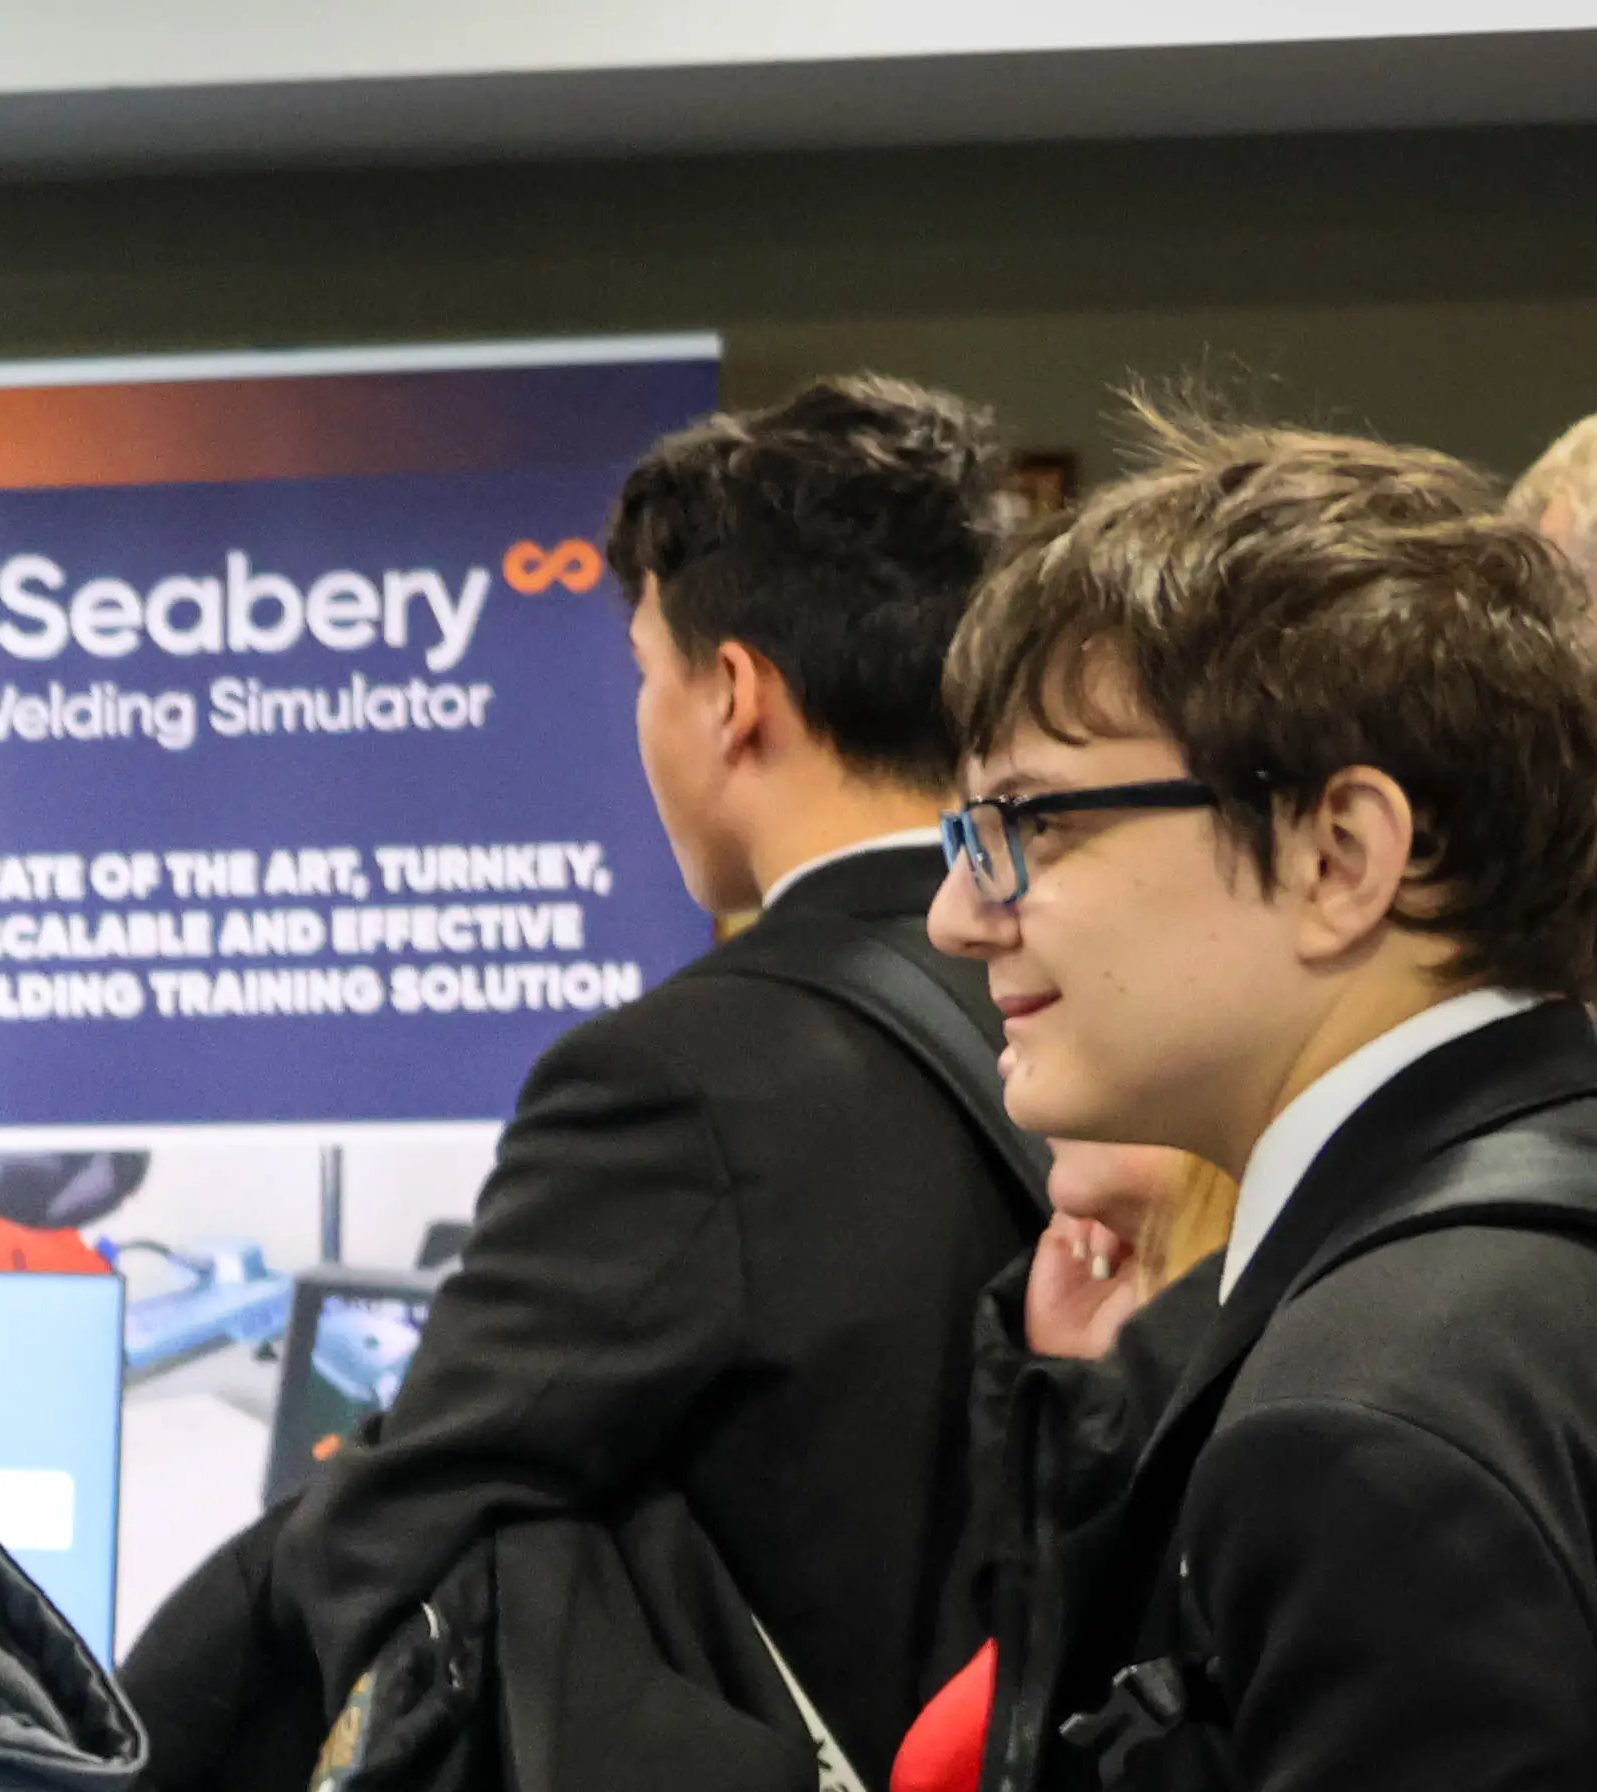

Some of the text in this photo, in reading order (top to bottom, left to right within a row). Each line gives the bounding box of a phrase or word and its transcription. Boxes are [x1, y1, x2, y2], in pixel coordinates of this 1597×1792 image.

[209, 670, 495, 737] Simulator
[90, 852, 161, 902] OF
[165, 849, 260, 900] THE
[264, 847, 370, 902] ART,
[375, 840, 612, 897] TURNKEY,
[217, 906, 327, 958] AND
[330, 902, 585, 955] EFFECTIVE
[148, 966, 386, 1019] TRAINING
[389, 960, 643, 1013] SOLUTION
